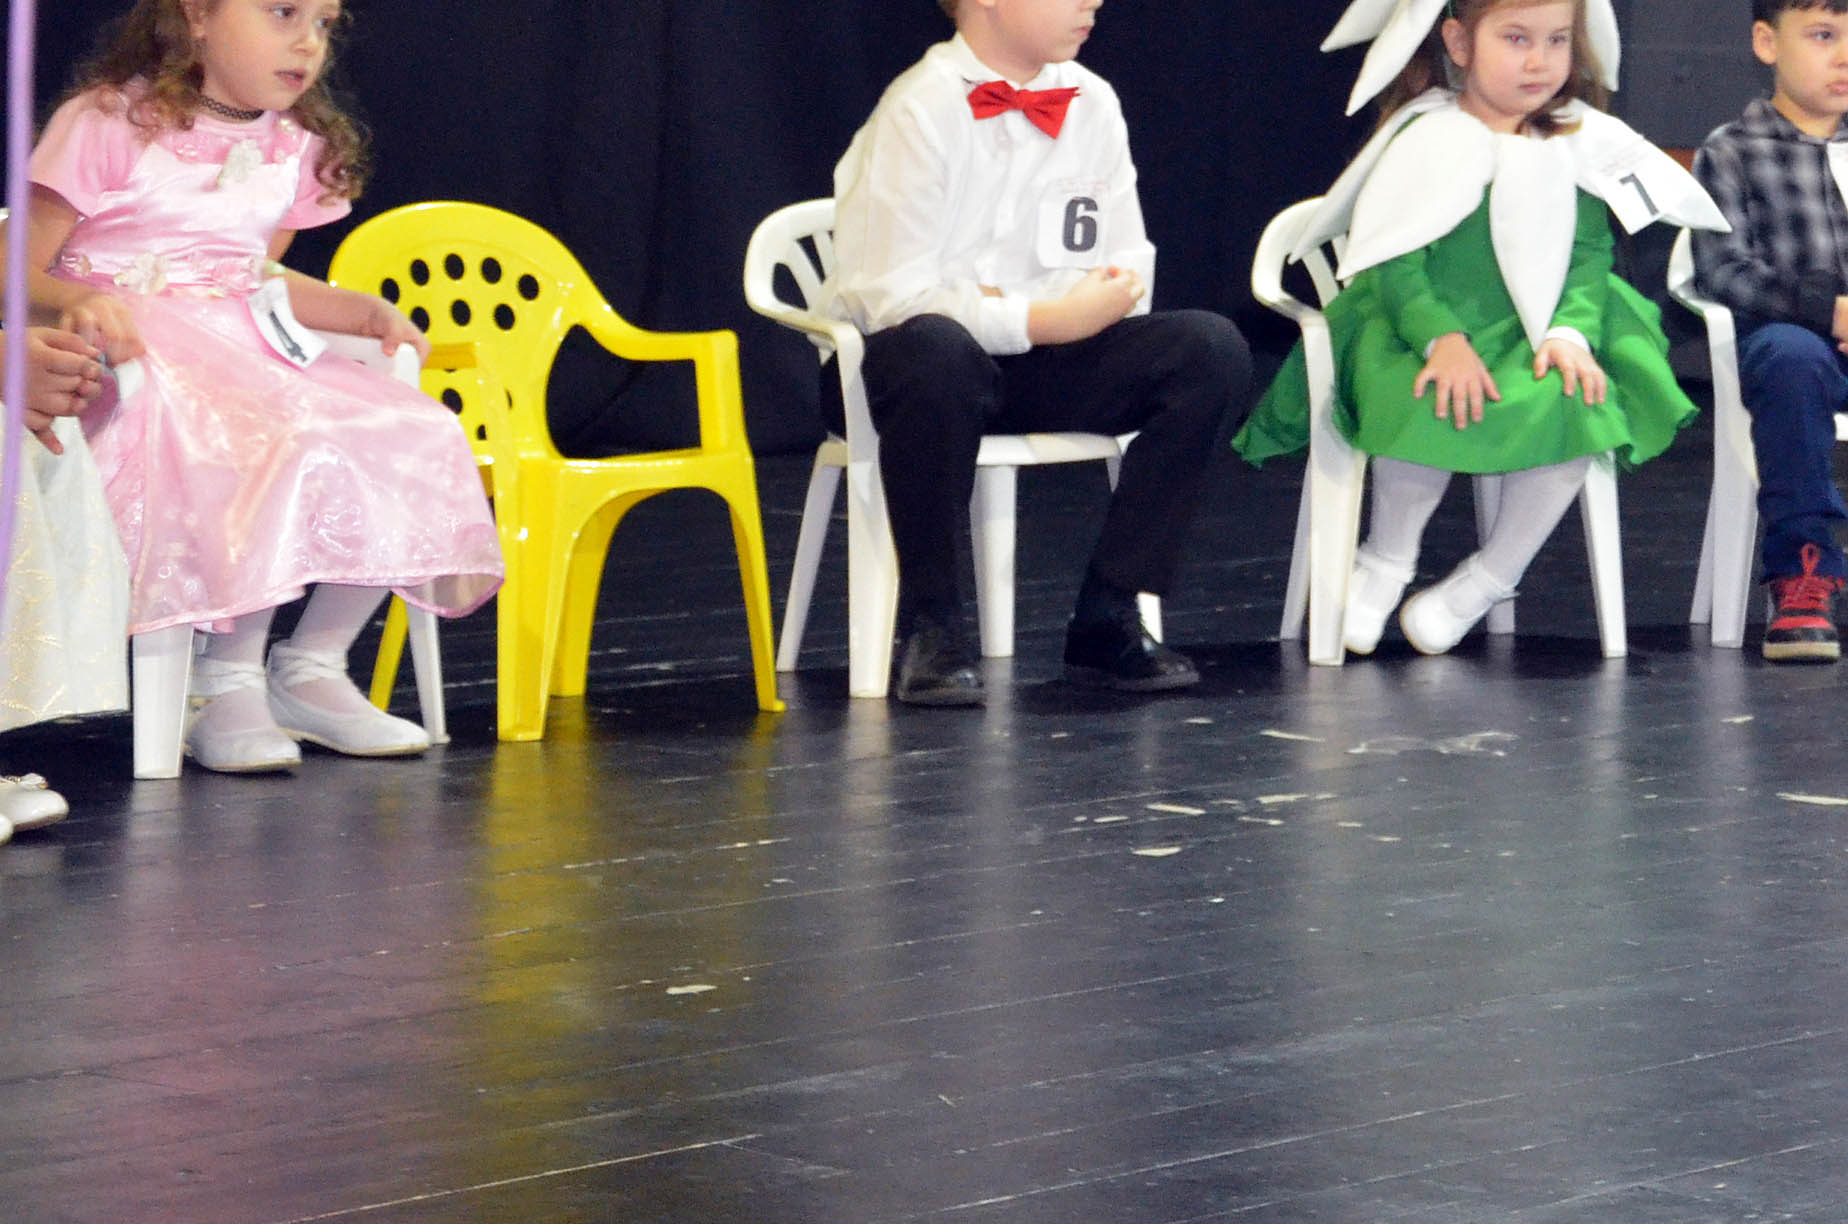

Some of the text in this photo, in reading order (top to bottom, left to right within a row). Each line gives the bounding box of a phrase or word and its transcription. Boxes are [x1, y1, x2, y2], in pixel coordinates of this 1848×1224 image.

[1618, 172, 1659, 216] 7
[1062, 196, 1098, 252] 6
[269, 309, 307, 362] 4
